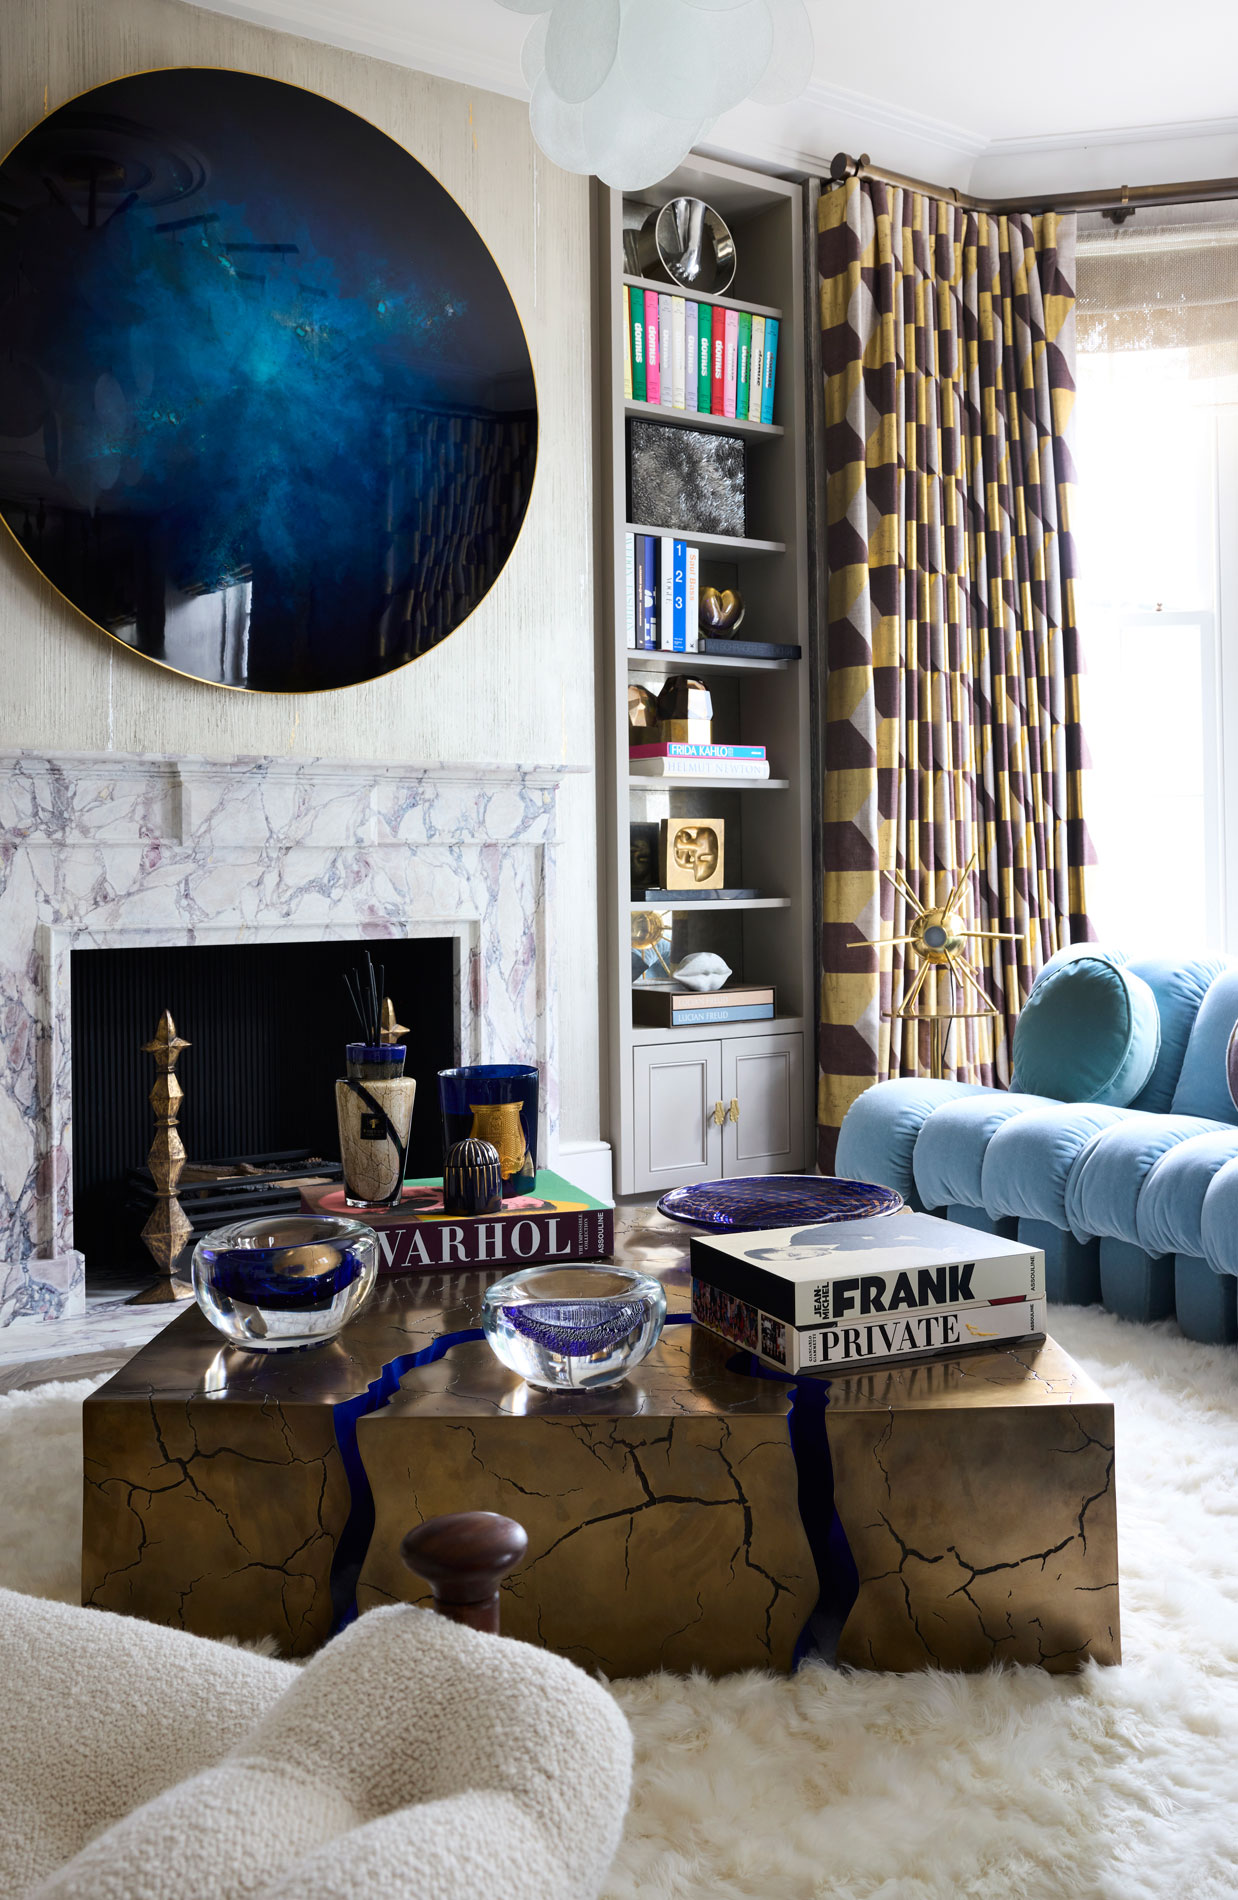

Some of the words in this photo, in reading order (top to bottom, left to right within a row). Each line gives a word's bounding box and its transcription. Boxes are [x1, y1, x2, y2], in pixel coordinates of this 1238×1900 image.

[634, 322, 642, 363] domus
[648, 325, 656, 366] domus
[701, 337, 709, 376] domus
[715, 340, 723, 379] domus
[676, 544, 682, 556] 1
[675, 570, 683, 583] 2
[675, 596, 682, 608] 3
[672, 744, 696, 756] FRIDA
[700, 745, 728, 757] KAHLO
[668, 760, 711, 773] HELMUT
[716, 763, 761, 774] NEWTON
[679, 1013, 704, 1022] LUCIAN
[706, 1011, 728, 1020] FREUD
[832, 1263, 976, 1318] FRANK
[819, 1314, 960, 1362] PRIVATE
